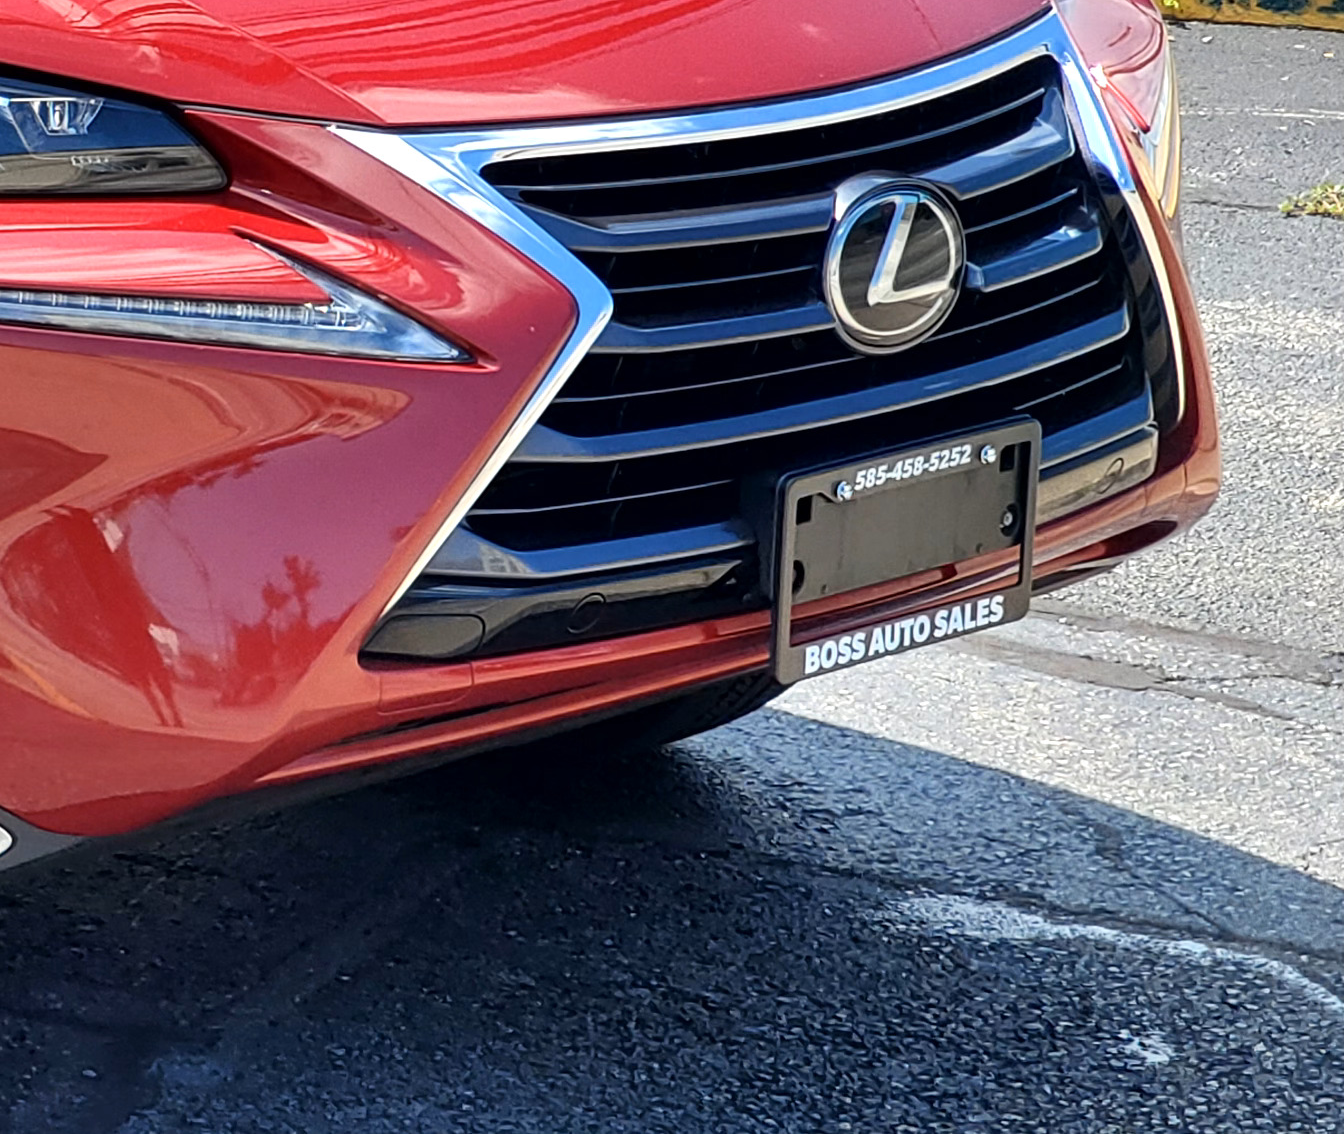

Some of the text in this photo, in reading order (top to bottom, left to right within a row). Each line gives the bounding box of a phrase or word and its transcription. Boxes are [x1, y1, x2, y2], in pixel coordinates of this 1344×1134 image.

[853, 444, 972, 492] 585-458-5252
[803, 593, 1005, 674] BOSS AUTO SALES
